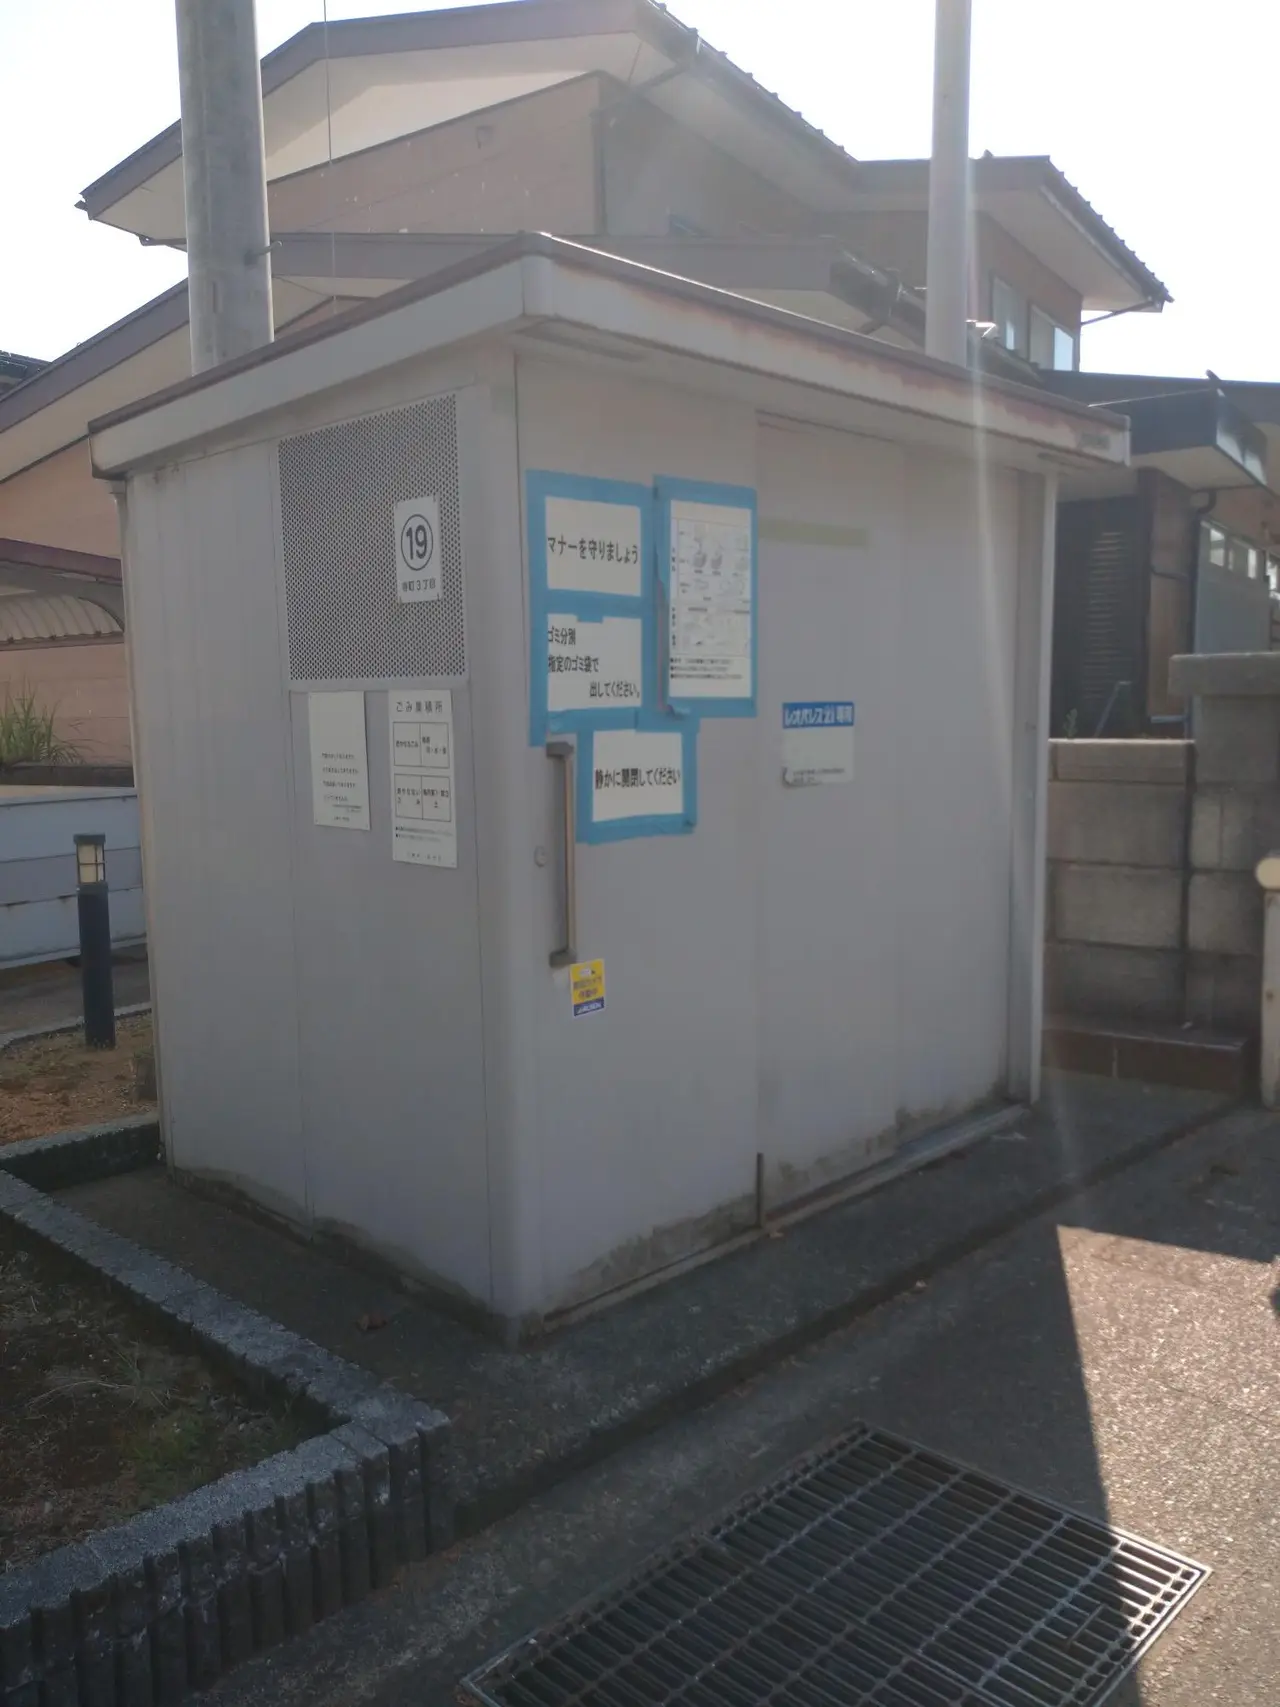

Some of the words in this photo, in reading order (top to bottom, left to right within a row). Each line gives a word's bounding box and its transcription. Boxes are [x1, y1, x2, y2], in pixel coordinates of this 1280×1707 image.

[406, 525, 427, 560] 19
[548, 534, 638, 564] マナーを守りましょう
[548, 626, 576, 646] ゴミ分別
[548, 655, 599, 673] 指定のゴミ袋で
